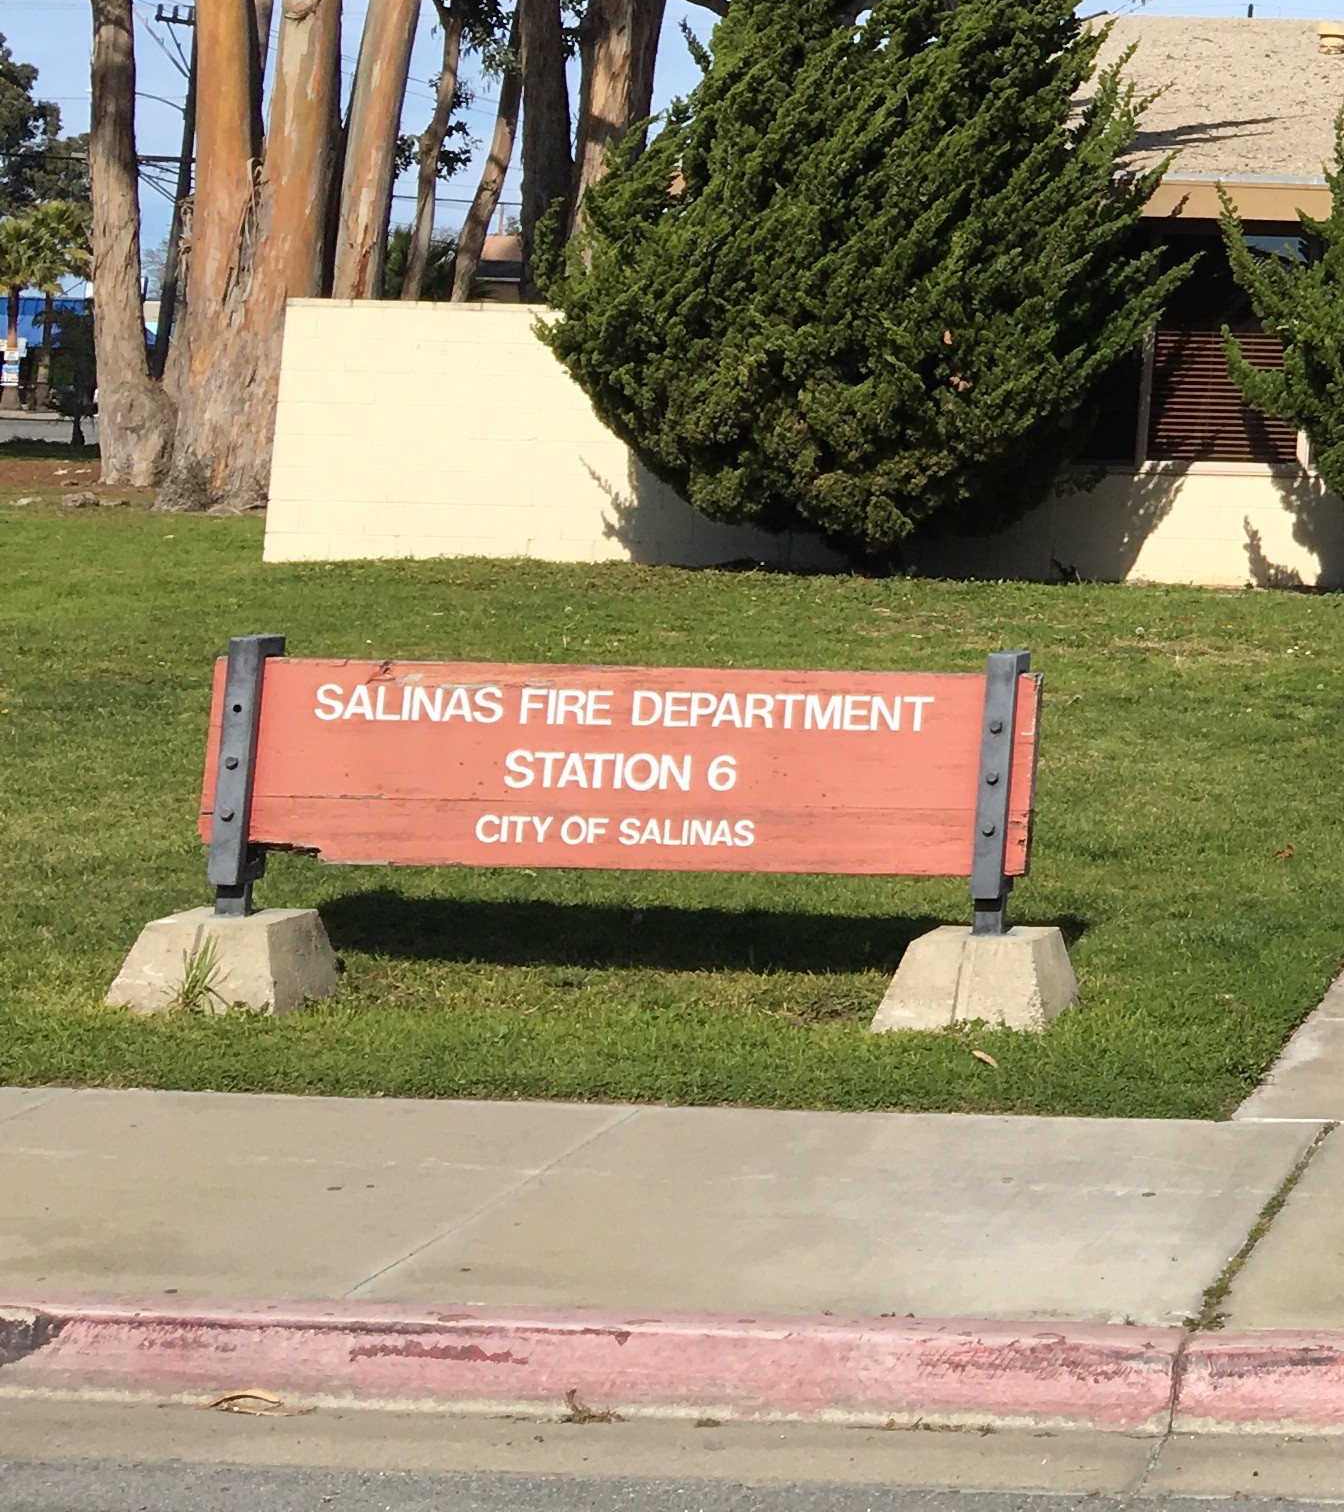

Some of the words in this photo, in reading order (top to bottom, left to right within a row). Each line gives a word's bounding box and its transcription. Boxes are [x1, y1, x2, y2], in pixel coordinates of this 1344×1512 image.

[314, 683, 504, 724] SALINAS
[518, 687, 614, 726] FIRE
[631, 690, 936, 732] DEPARTMENT
[503, 748, 692, 792] STATION
[707, 754, 737, 792] 6
[475, 814, 554, 844] CITY
[560, 815, 610, 845] OF
[618, 817, 756, 848] SALINAS
